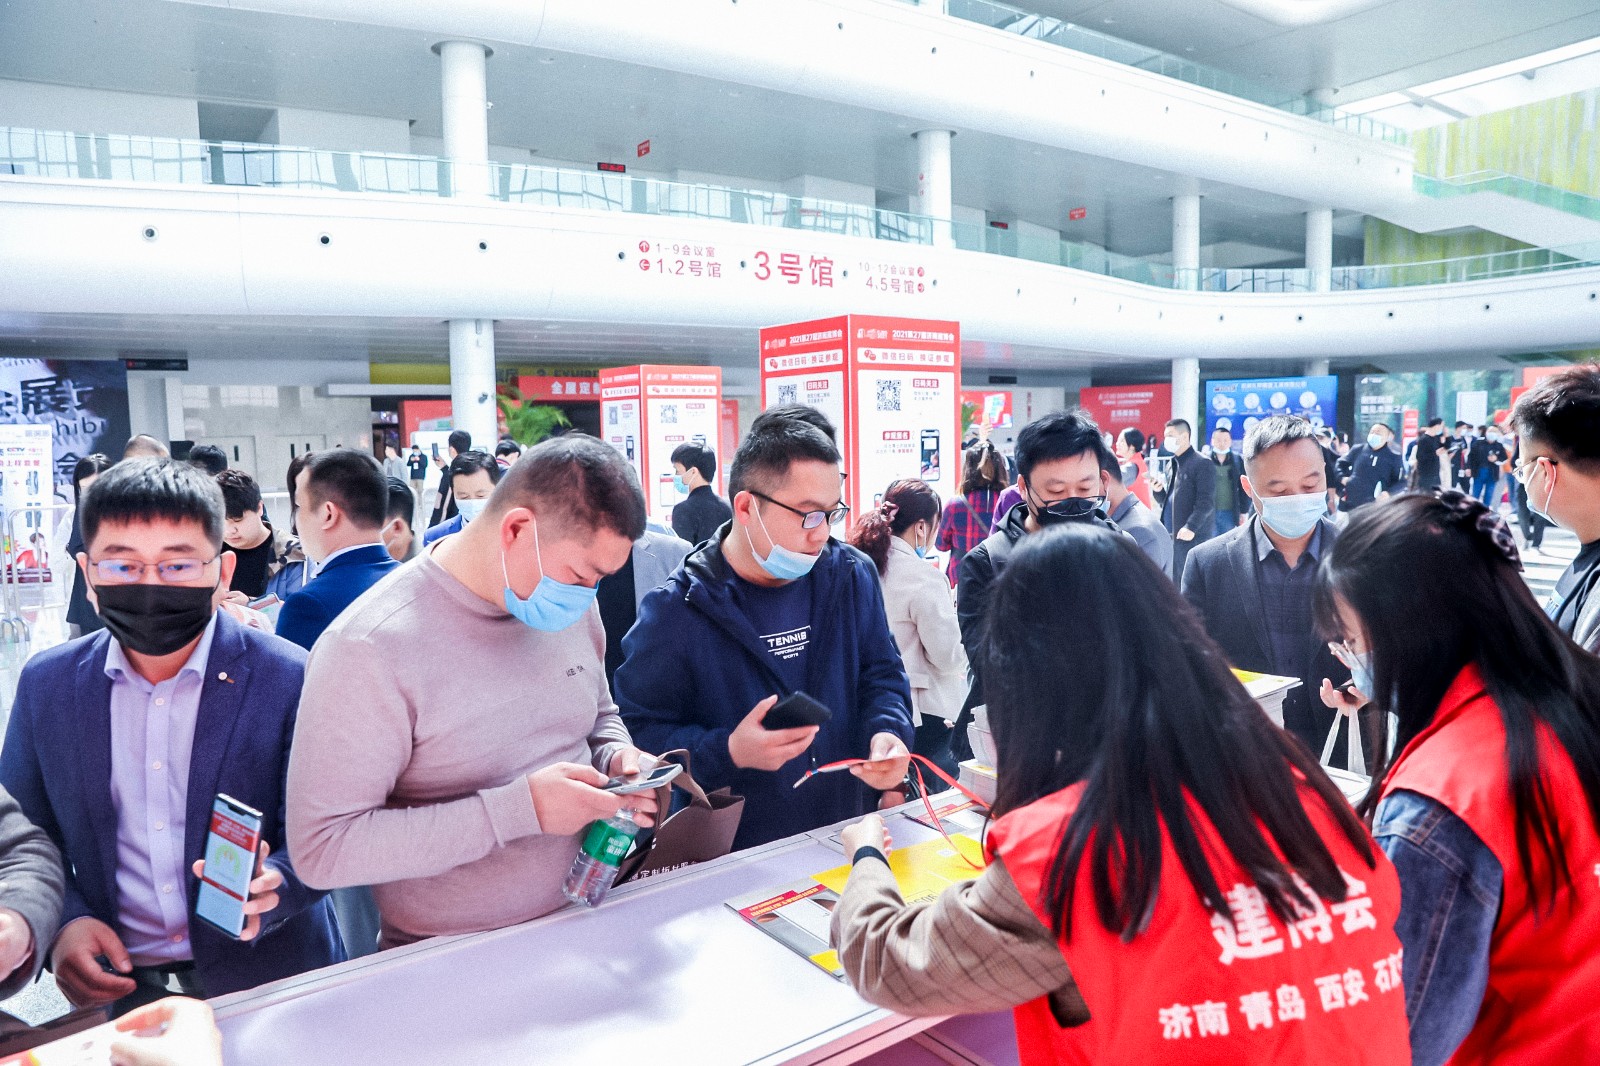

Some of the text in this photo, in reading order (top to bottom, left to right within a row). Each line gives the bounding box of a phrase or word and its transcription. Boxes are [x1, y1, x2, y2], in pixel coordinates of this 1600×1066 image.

[754, 250, 834, 288] 3号馆
[767, 631, 807, 648] TENNIS
[1158, 1000, 1229, 1039] 济南
[1239, 984, 1306, 1030] 青岛
[1314, 967, 1369, 1012] 西安
